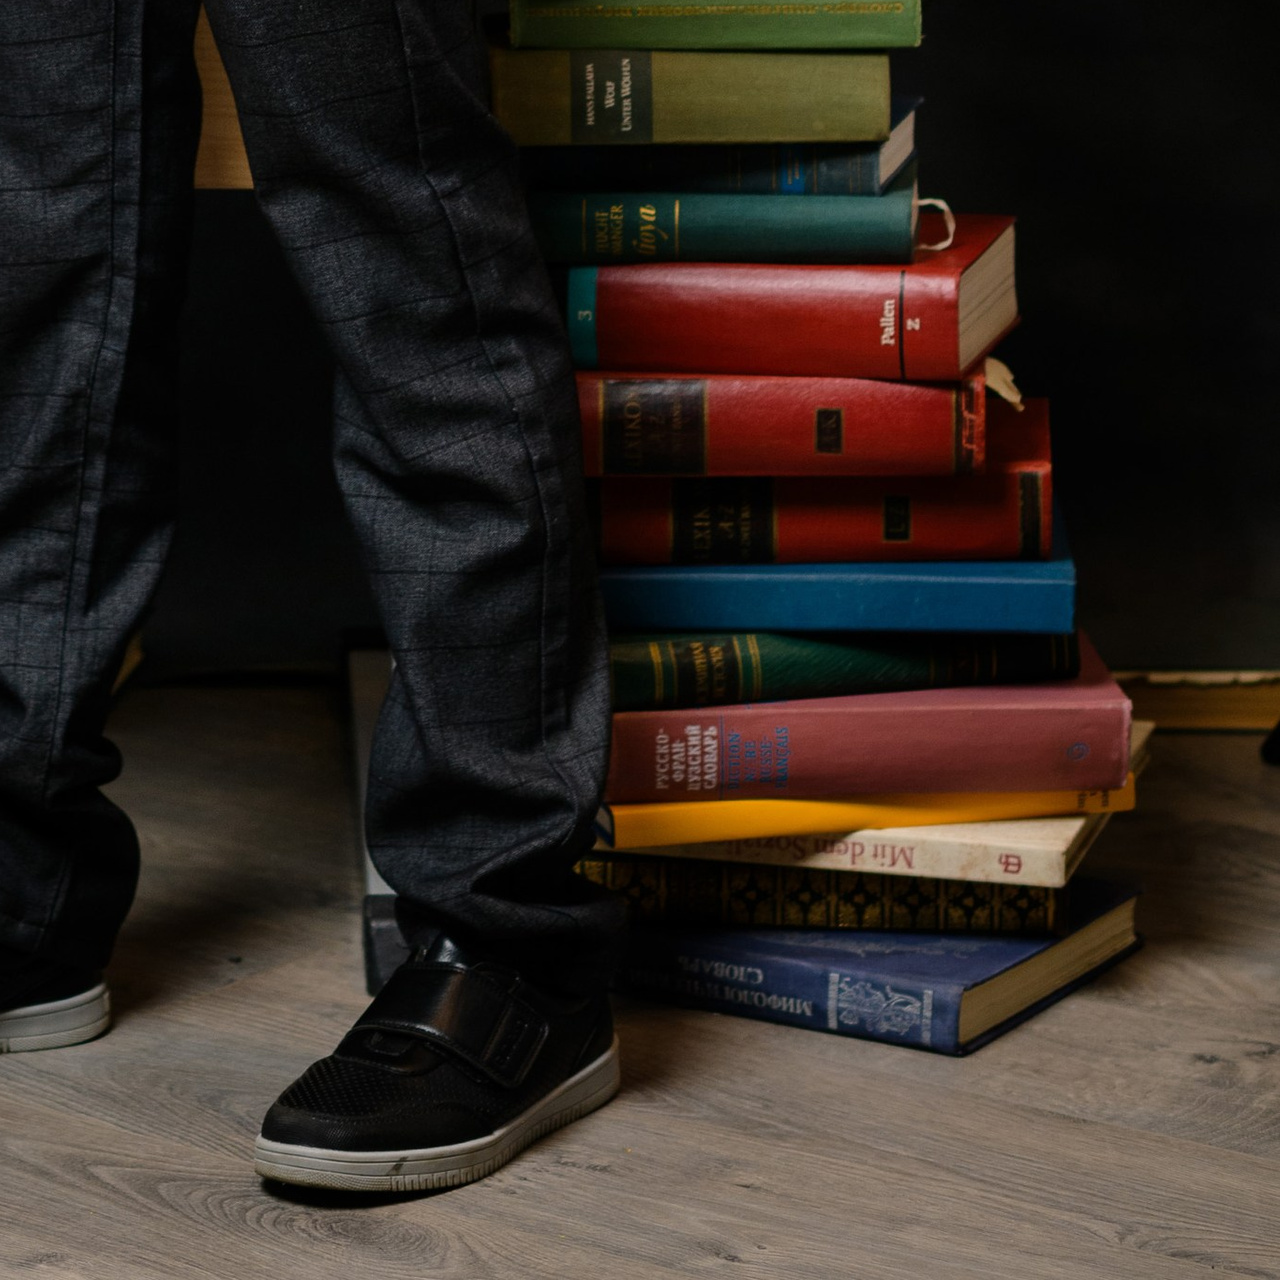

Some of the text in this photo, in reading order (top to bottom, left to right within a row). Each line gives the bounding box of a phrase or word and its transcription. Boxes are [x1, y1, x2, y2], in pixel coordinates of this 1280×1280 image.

[585, 63, 595, 126] HANS FALLADA
[577, 309, 592, 322] 3
[655, 728, 670, 790] РУССКО-
[672, 740, 686, 782] ФРАН-
[684, 725, 702, 791] ЦУЗСКИЙ
[703, 725, 718, 790] СЛОВАРЬ
[814, 838, 865, 866] dem
[871, 843, 915, 870] Mit
[677, 955, 764, 986] СЛОВАРЬ
